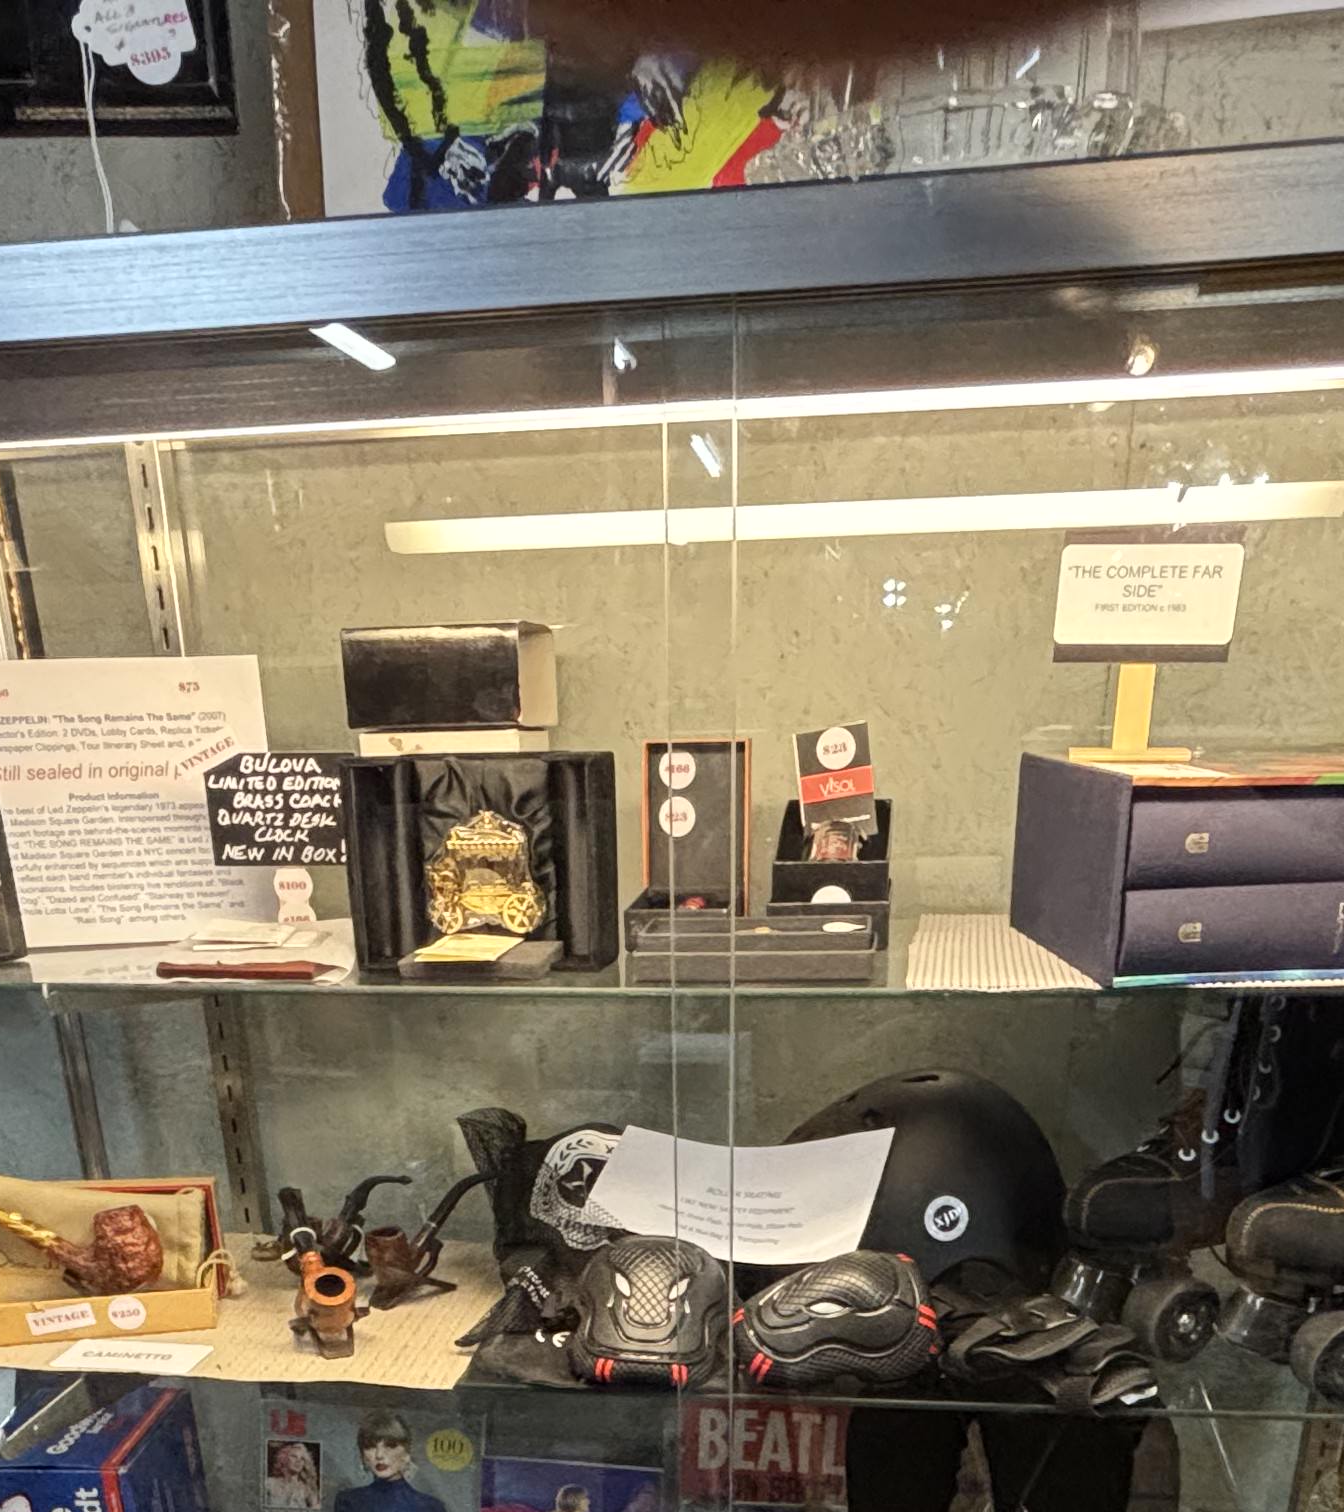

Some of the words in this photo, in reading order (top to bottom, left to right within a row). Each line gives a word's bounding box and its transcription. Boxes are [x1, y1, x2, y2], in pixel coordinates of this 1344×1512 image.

[1106, 565, 1189, 580] COMPLETE
[1192, 565, 1224, 580] FAR
[1094, 603, 1120, 613] FIRST
[1122, 603, 1157, 613] EDITION
[77, 714, 102, 727] Song
[104, 713, 145, 724] Remains
[100, 726, 127, 739] Lobby
[179, 736, 236, 772] VINTAGE
[26, 762, 83, 781] sealed
[87, 762, 104, 780] in
[107, 761, 170, 783] original
[238, 752, 322, 775] BULOVA
[207, 775, 278, 791] LIMITED
[68, 791, 106, 804] Product
[232, 793, 284, 810] BRASS
[216, 808, 285, 827] QUARTZ
[289, 812, 338, 828] DESK
[254, 826, 311, 844] CLOCK
[222, 844, 266, 862] NEW
[271, 846, 295, 862] IN
[300, 839, 349, 864] BOX!
[32, 1309, 91, 1328] VINTAGE
[81, 1350, 174, 1362] CAMINETTO
